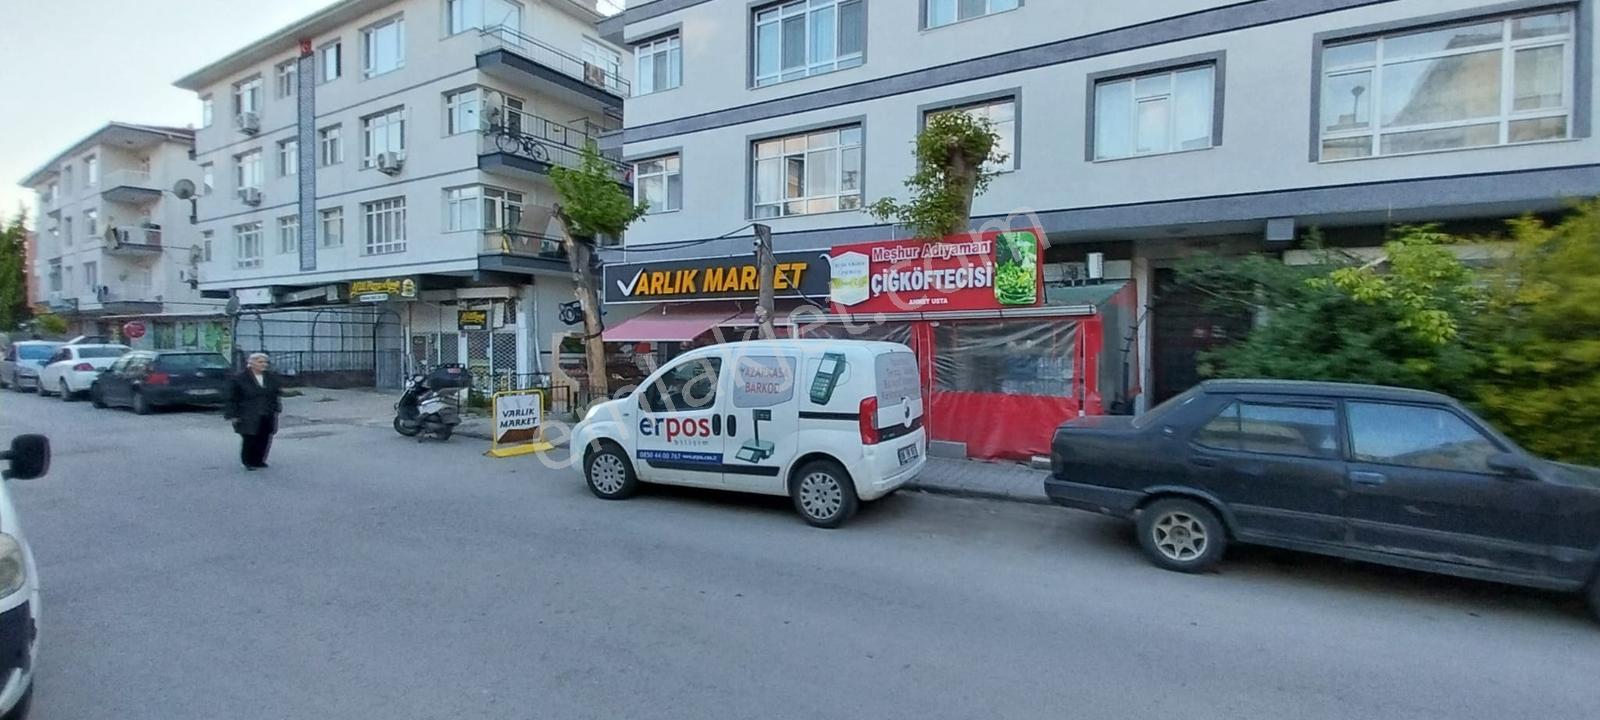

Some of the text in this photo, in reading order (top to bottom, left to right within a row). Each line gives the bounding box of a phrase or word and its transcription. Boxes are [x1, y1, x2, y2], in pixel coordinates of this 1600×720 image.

[871, 246, 918, 264] Meşhur
[702, 262, 808, 293] MARET
[871, 262, 992, 297] ÇİĞKÖFTECİSİ
[500, 417, 537, 428] MARKET
[503, 408, 535, 418] VARLIK
[640, 417, 711, 442] erpos
